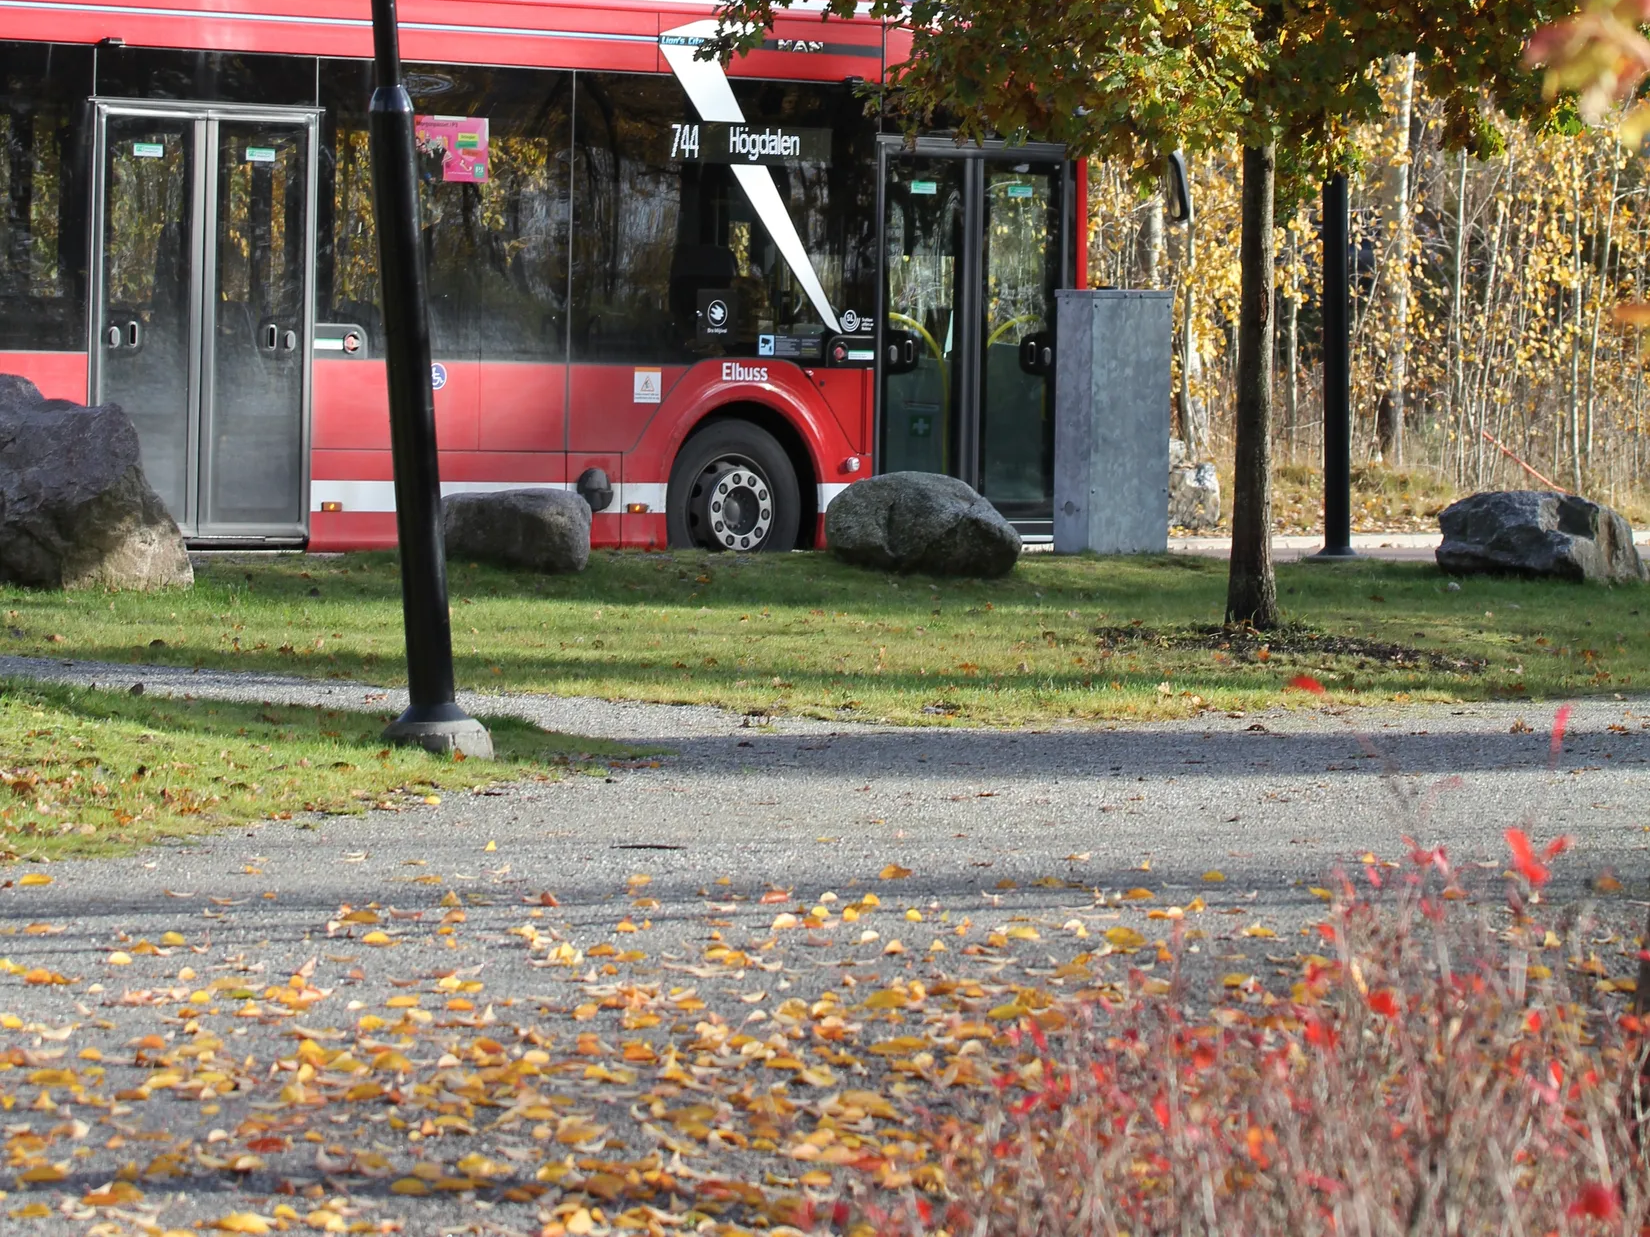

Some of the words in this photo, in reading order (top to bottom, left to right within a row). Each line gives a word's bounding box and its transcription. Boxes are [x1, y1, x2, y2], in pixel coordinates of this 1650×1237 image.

[661, 36, 685, 45] Lion's
[777, 38, 824, 53] MAN
[671, 123, 700, 159] 744
[729, 126, 800, 161] Högdalen
[846, 313, 854, 322] SL
[722, 362, 768, 381] Elbuss
